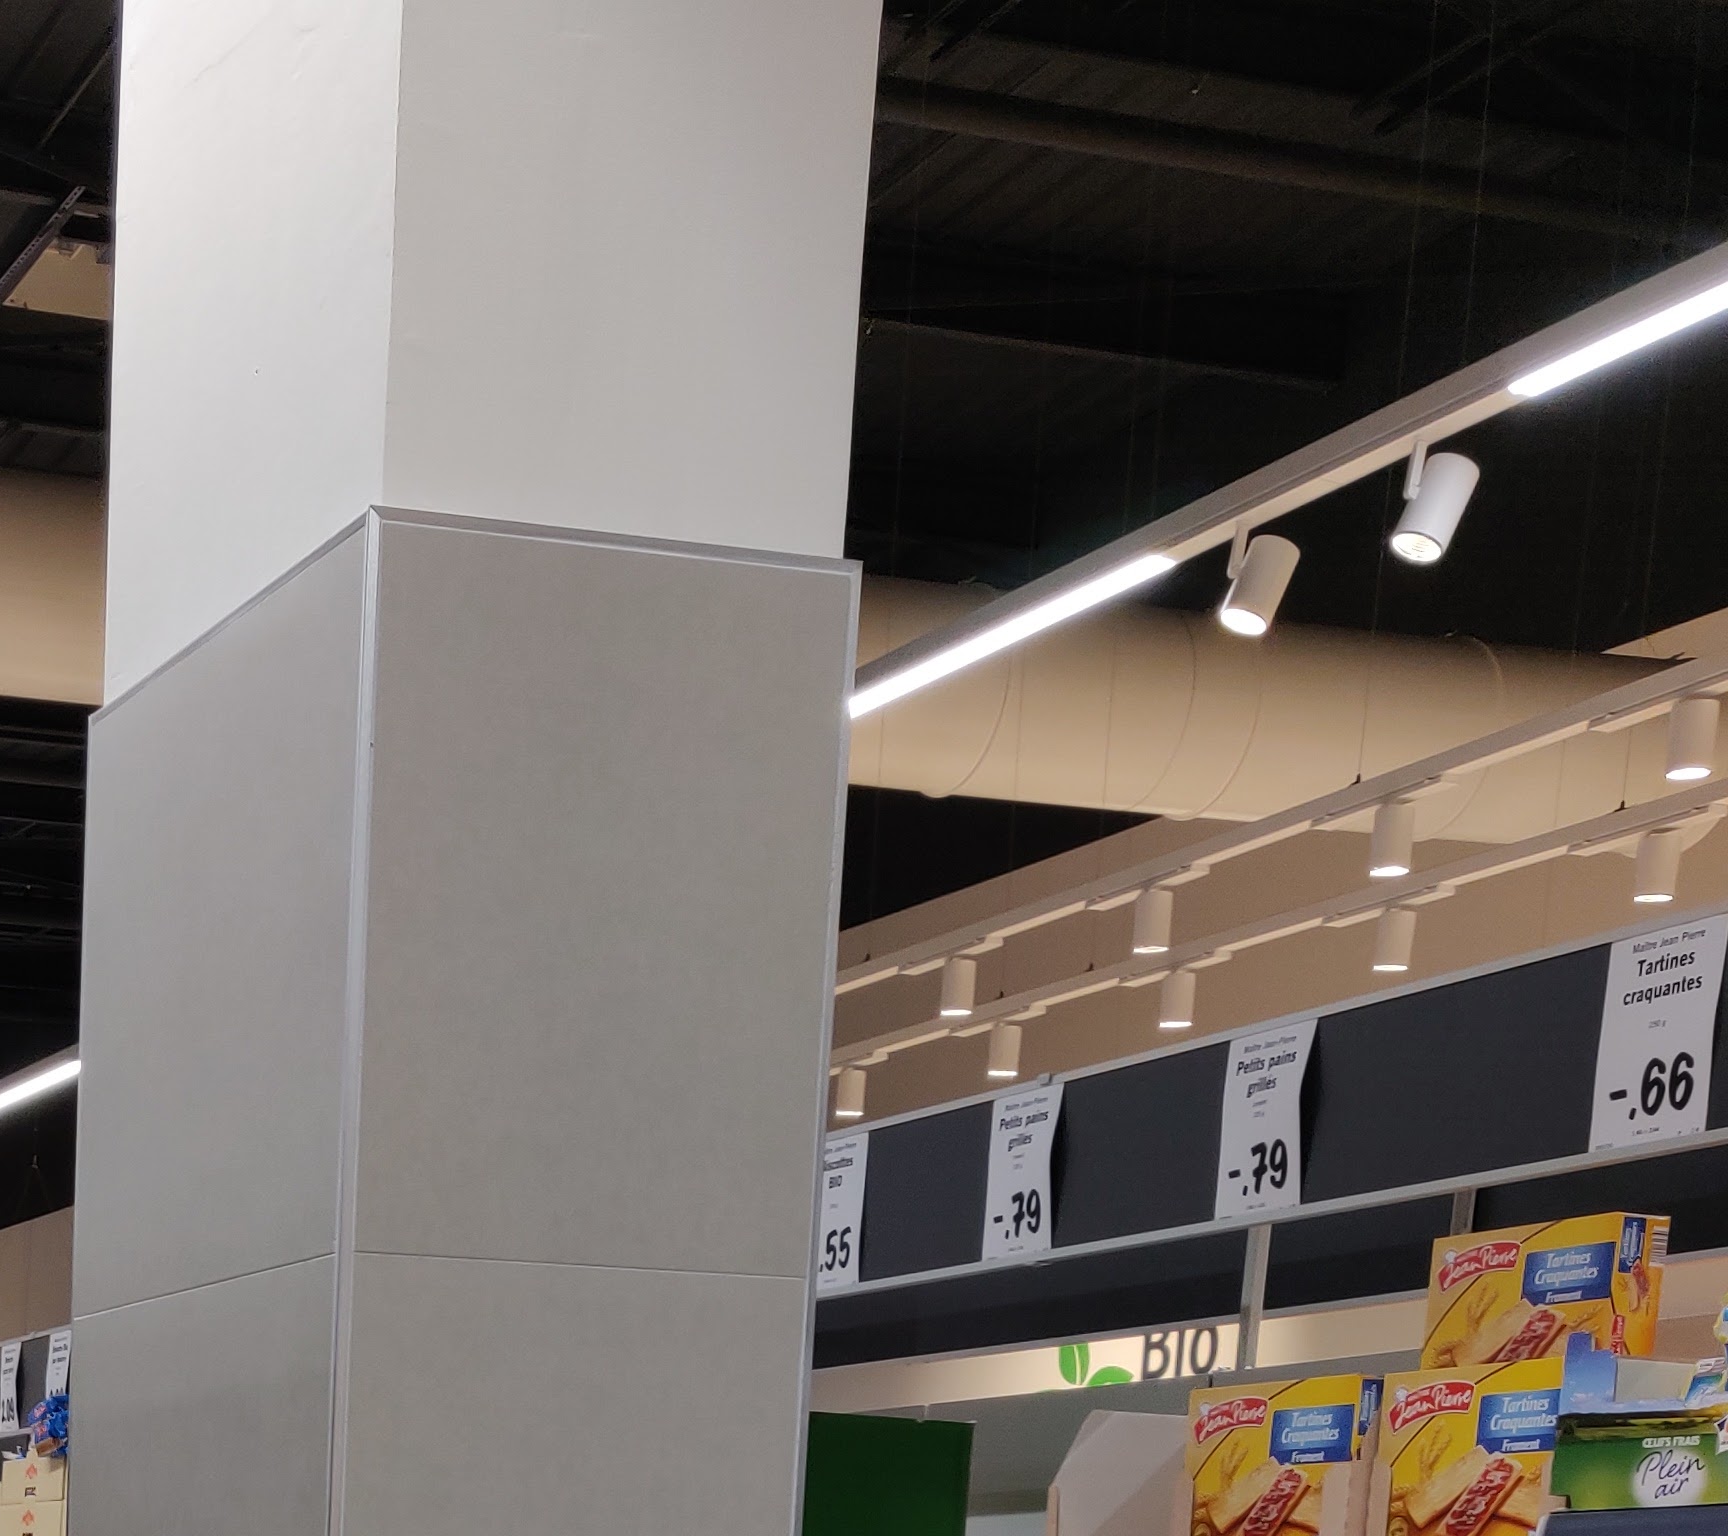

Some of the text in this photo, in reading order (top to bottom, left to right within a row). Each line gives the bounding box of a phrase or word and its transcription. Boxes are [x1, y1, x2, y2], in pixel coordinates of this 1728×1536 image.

[1637, 951, 1696, 977] Tartines
[1623, 974, 1704, 1006] craquantes
[1236, 1050, 1298, 1077] Petits pains
[1609, 1051, 1695, 1121] -.66
[1228, 1138, 1288, 1197] -.79
[993, 1188, 1042, 1240] -.79
[1479, 1244, 1518, 1268] Pierre
[1546, 1251, 1592, 1269] Tartines
[1534, 1265, 1599, 1286] Craquantes
[1230, 1399, 1266, 1423] Pierre
[1394, 1400, 1435, 1430] Jean
[1431, 1383, 1472, 1410] Pierre
[1502, 1394, 1551, 1413] Tartines
[1291, 1410, 1334, 1427] Tartines
[1490, 1412, 1559, 1434] Craquantes
[1282, 1427, 1341, 1446] Craquantes
[1673, 1434, 1701, 1447] FRAIS
[1636, 1449, 1706, 1487] Plein
[1654, 1477, 1689, 1500] air
